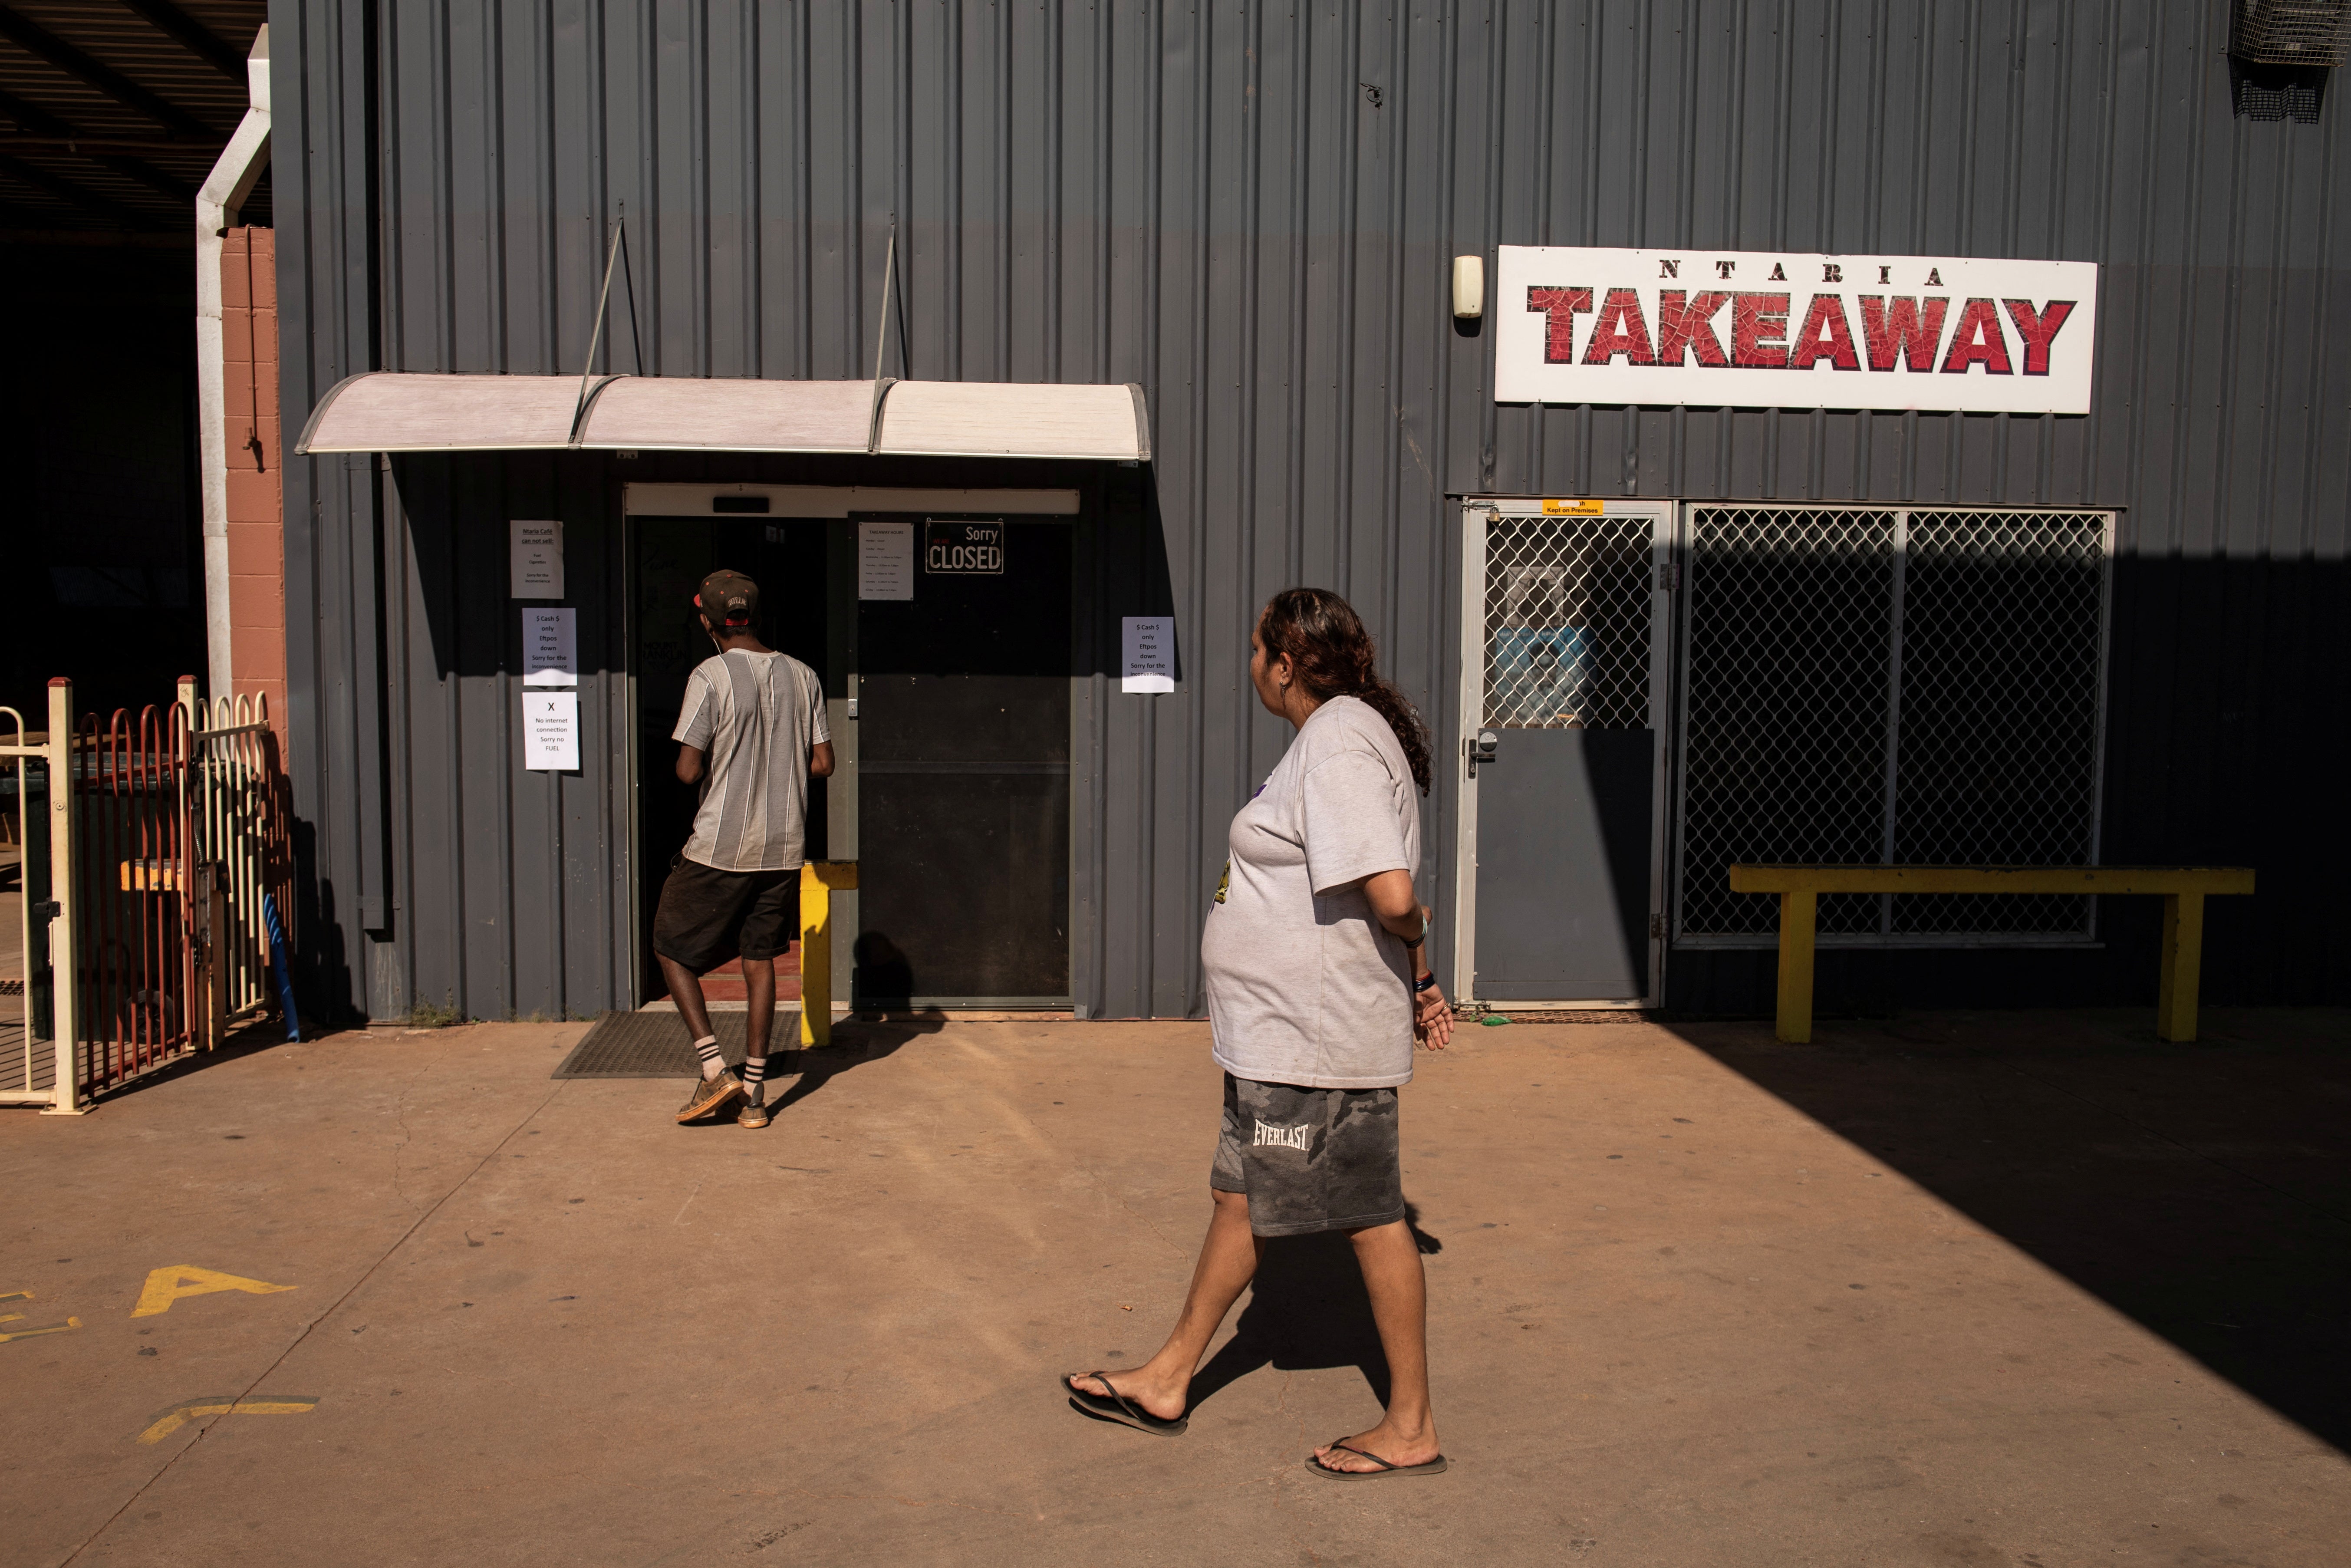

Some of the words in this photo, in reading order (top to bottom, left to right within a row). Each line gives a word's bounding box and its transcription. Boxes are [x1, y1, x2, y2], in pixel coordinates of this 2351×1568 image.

[1659, 259, 1943, 286] NTARIA
[1527, 285, 2078, 376] TAKEAWAY
[966, 527, 998, 544] Sorry
[930, 546, 1001, 569] CLOSED
[728, 597, 746, 607] BULLS
[548, 702, 555, 711] X
[1253, 1118, 1308, 1151] EVERLAST
